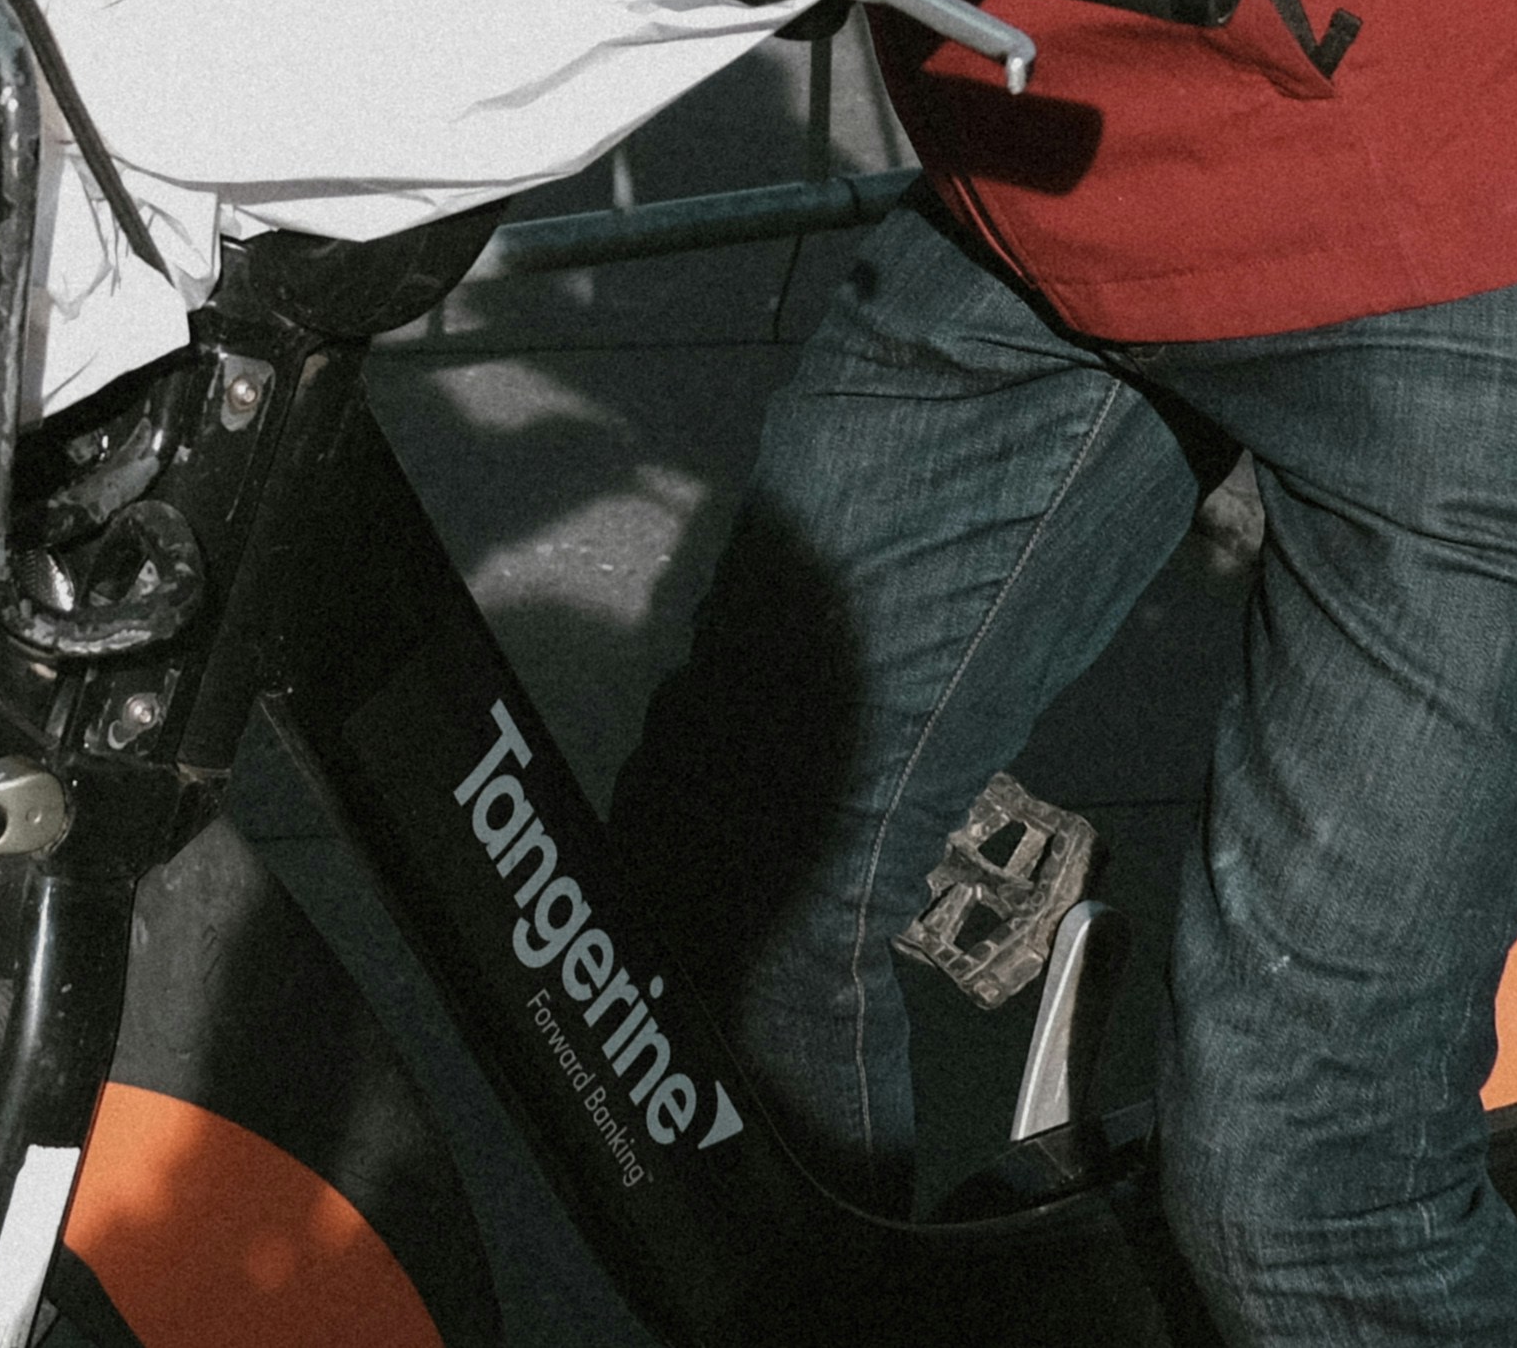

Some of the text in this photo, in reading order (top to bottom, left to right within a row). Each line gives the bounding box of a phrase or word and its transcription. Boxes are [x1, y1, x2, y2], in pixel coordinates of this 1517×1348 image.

[452, 697, 698, 1145] Tangerine
[526, 988, 646, 1188] Forward Banking
